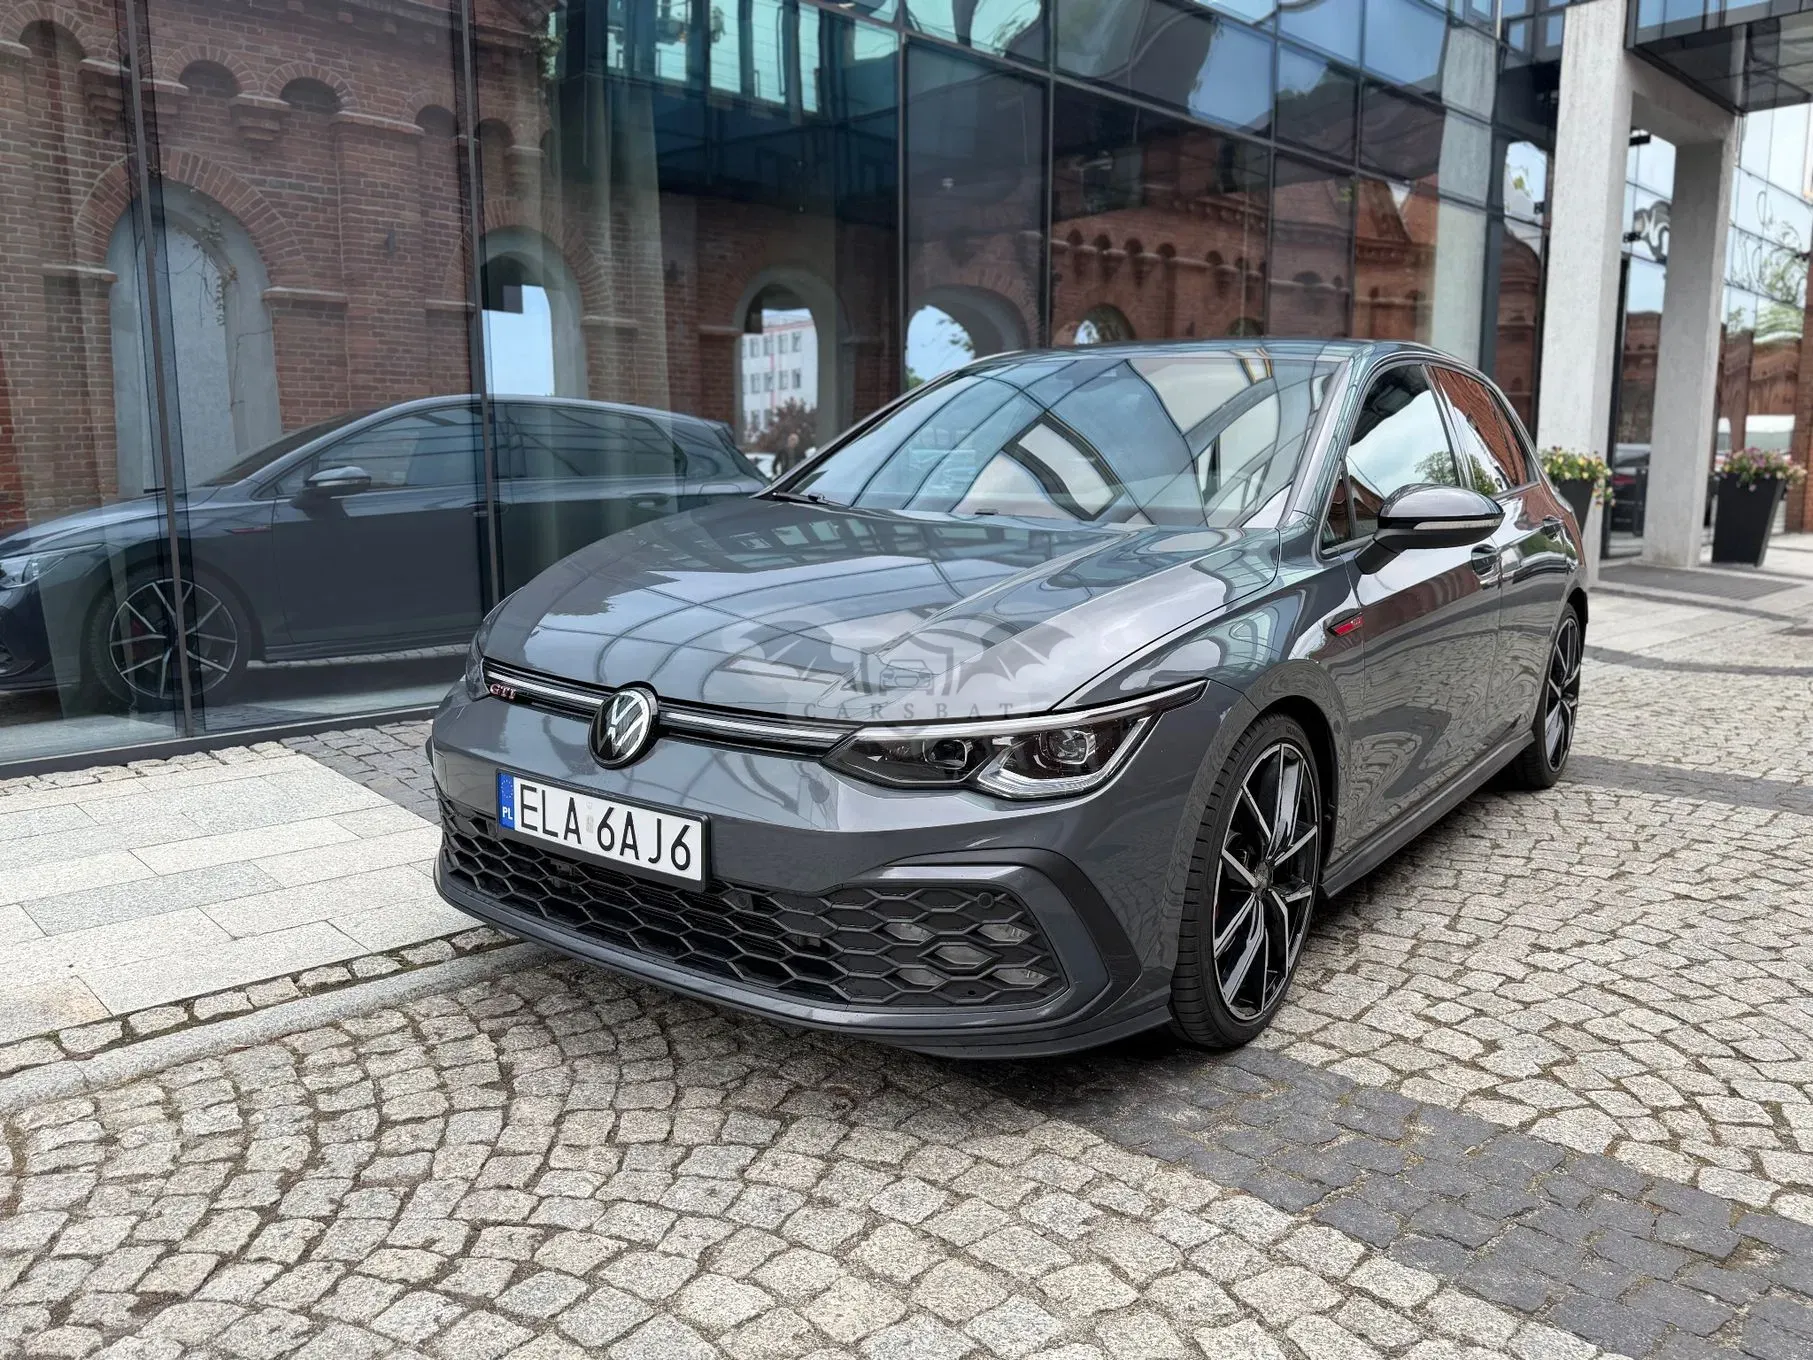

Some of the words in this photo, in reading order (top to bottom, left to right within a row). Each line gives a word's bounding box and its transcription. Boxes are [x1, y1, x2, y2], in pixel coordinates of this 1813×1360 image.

[490, 683, 516, 700] GTI
[502, 806, 514, 820] PL
[519, 783, 582, 844] ELA
[596, 806, 692, 871] 6AJ6
